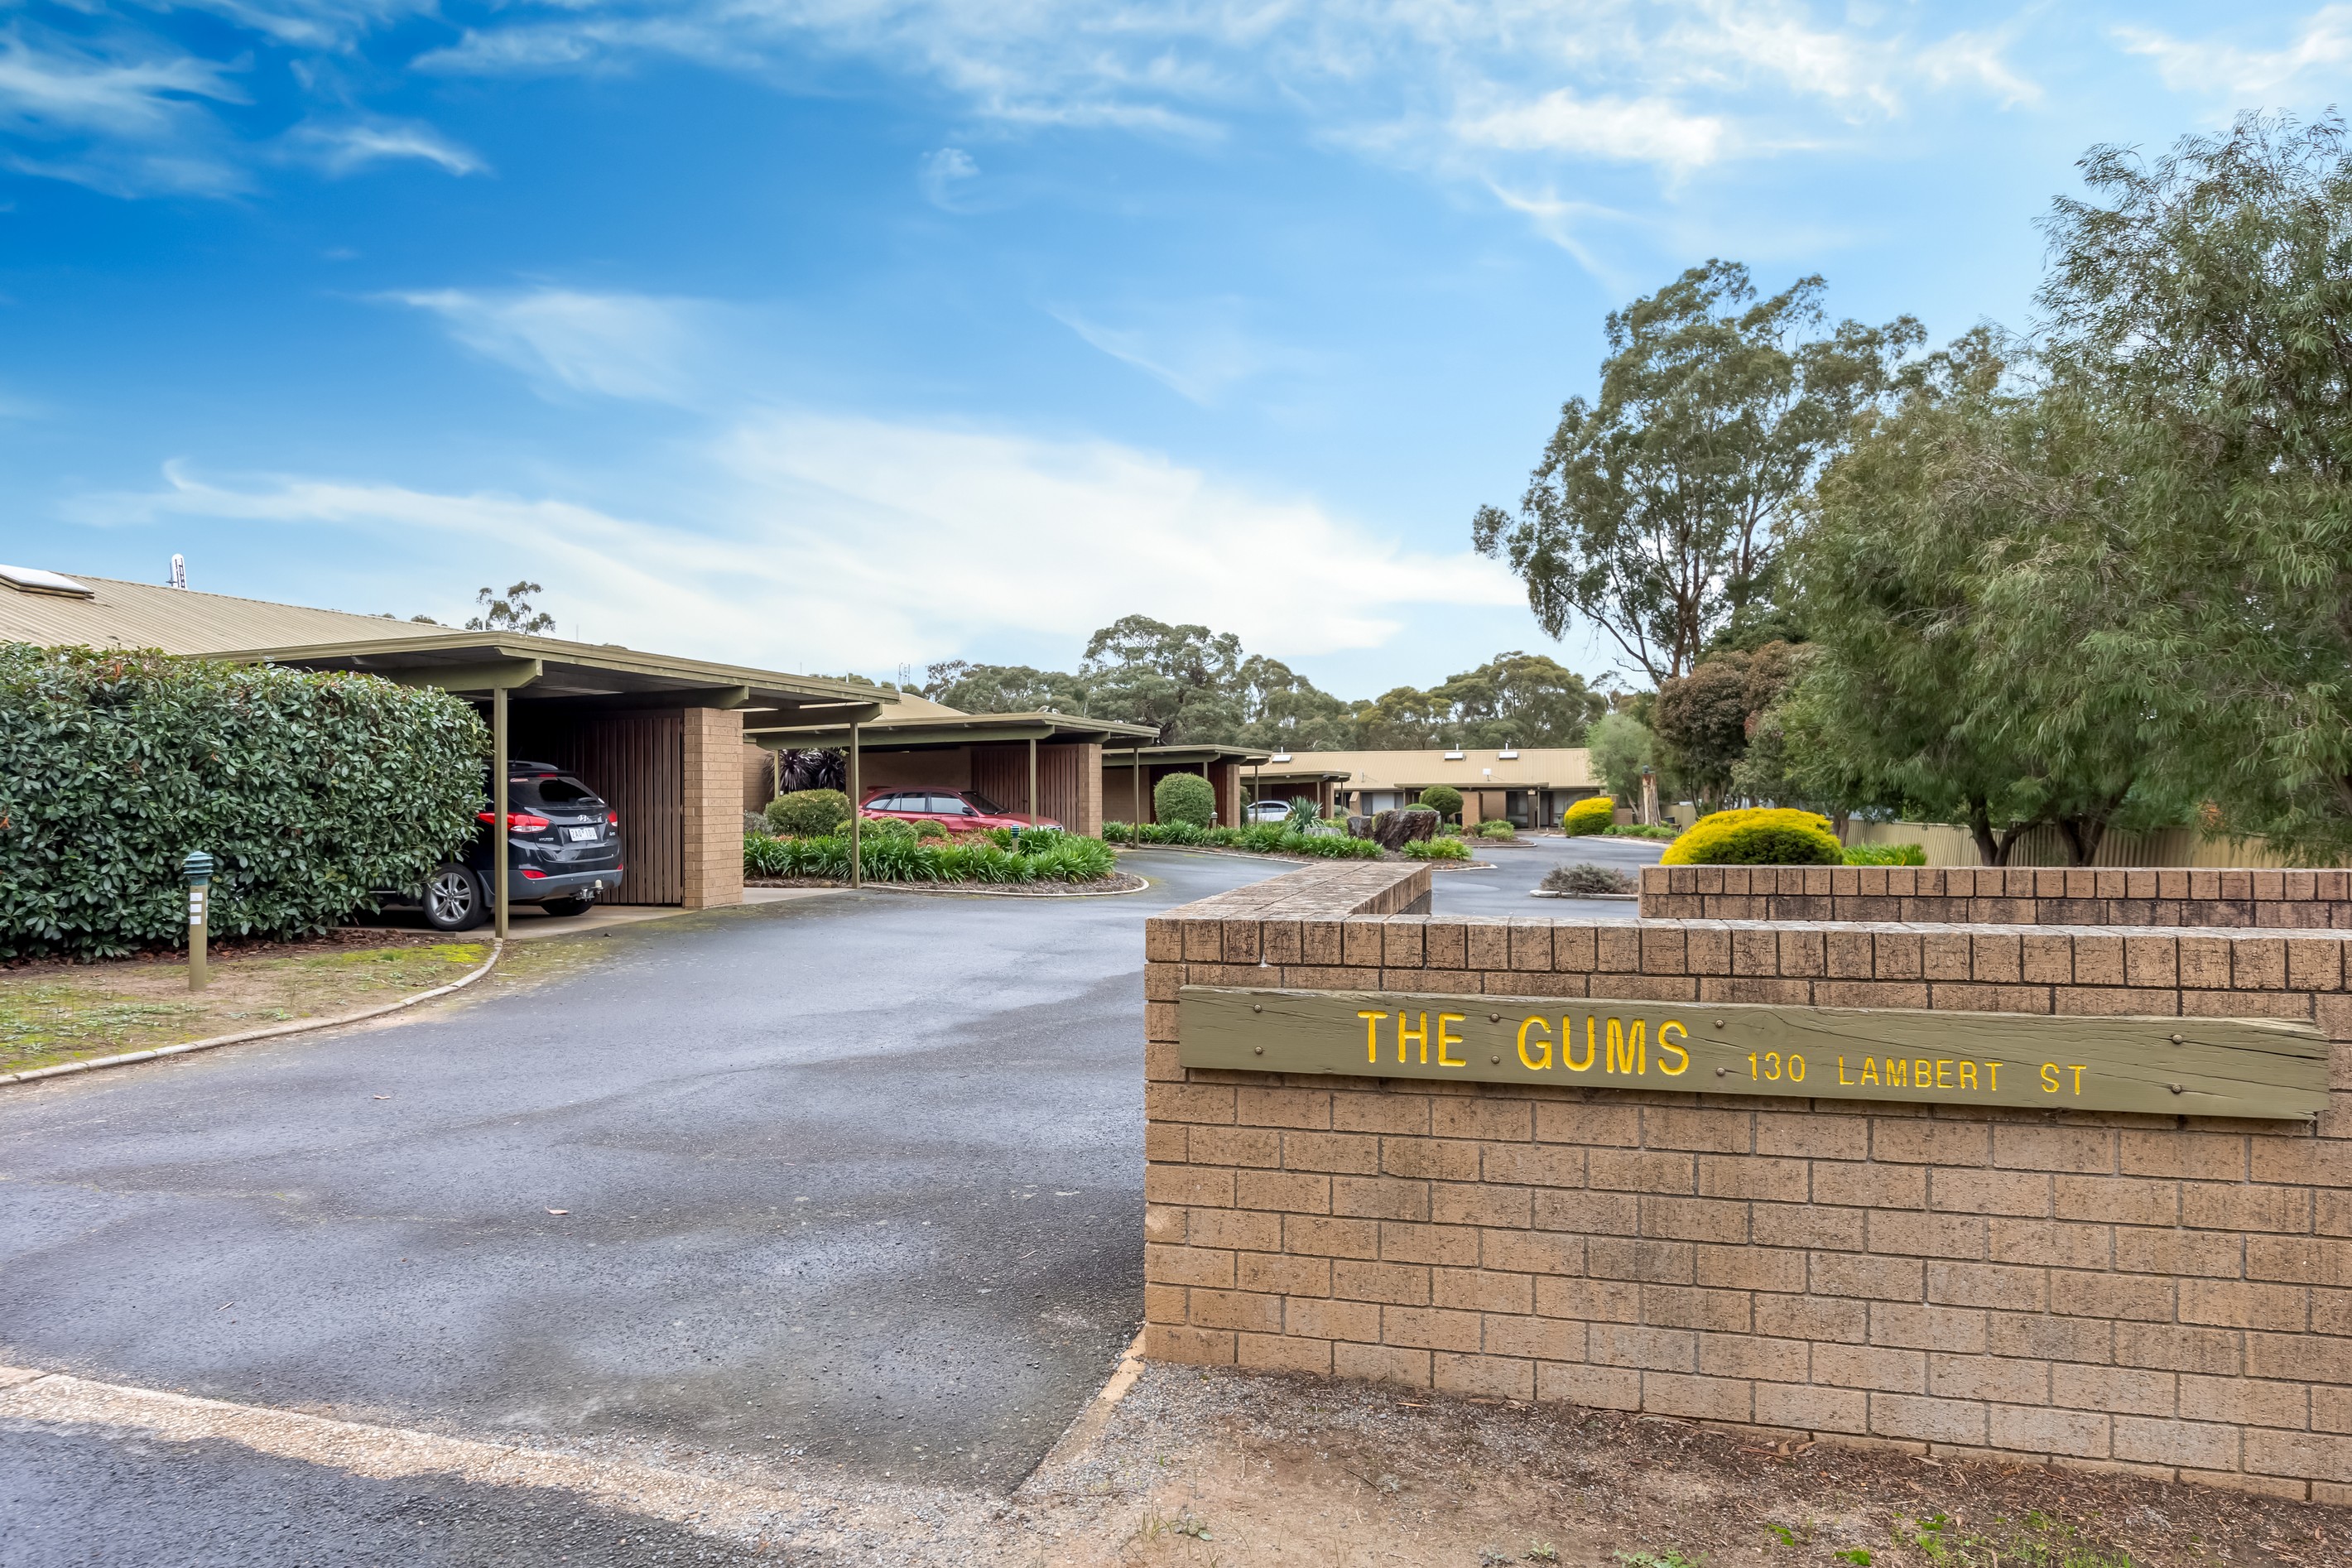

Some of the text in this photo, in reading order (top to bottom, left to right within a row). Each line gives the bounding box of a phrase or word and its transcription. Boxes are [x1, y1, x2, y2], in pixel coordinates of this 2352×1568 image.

[1357, 1010, 2087, 1095] THE GUMS 130 LAMBERT ST
